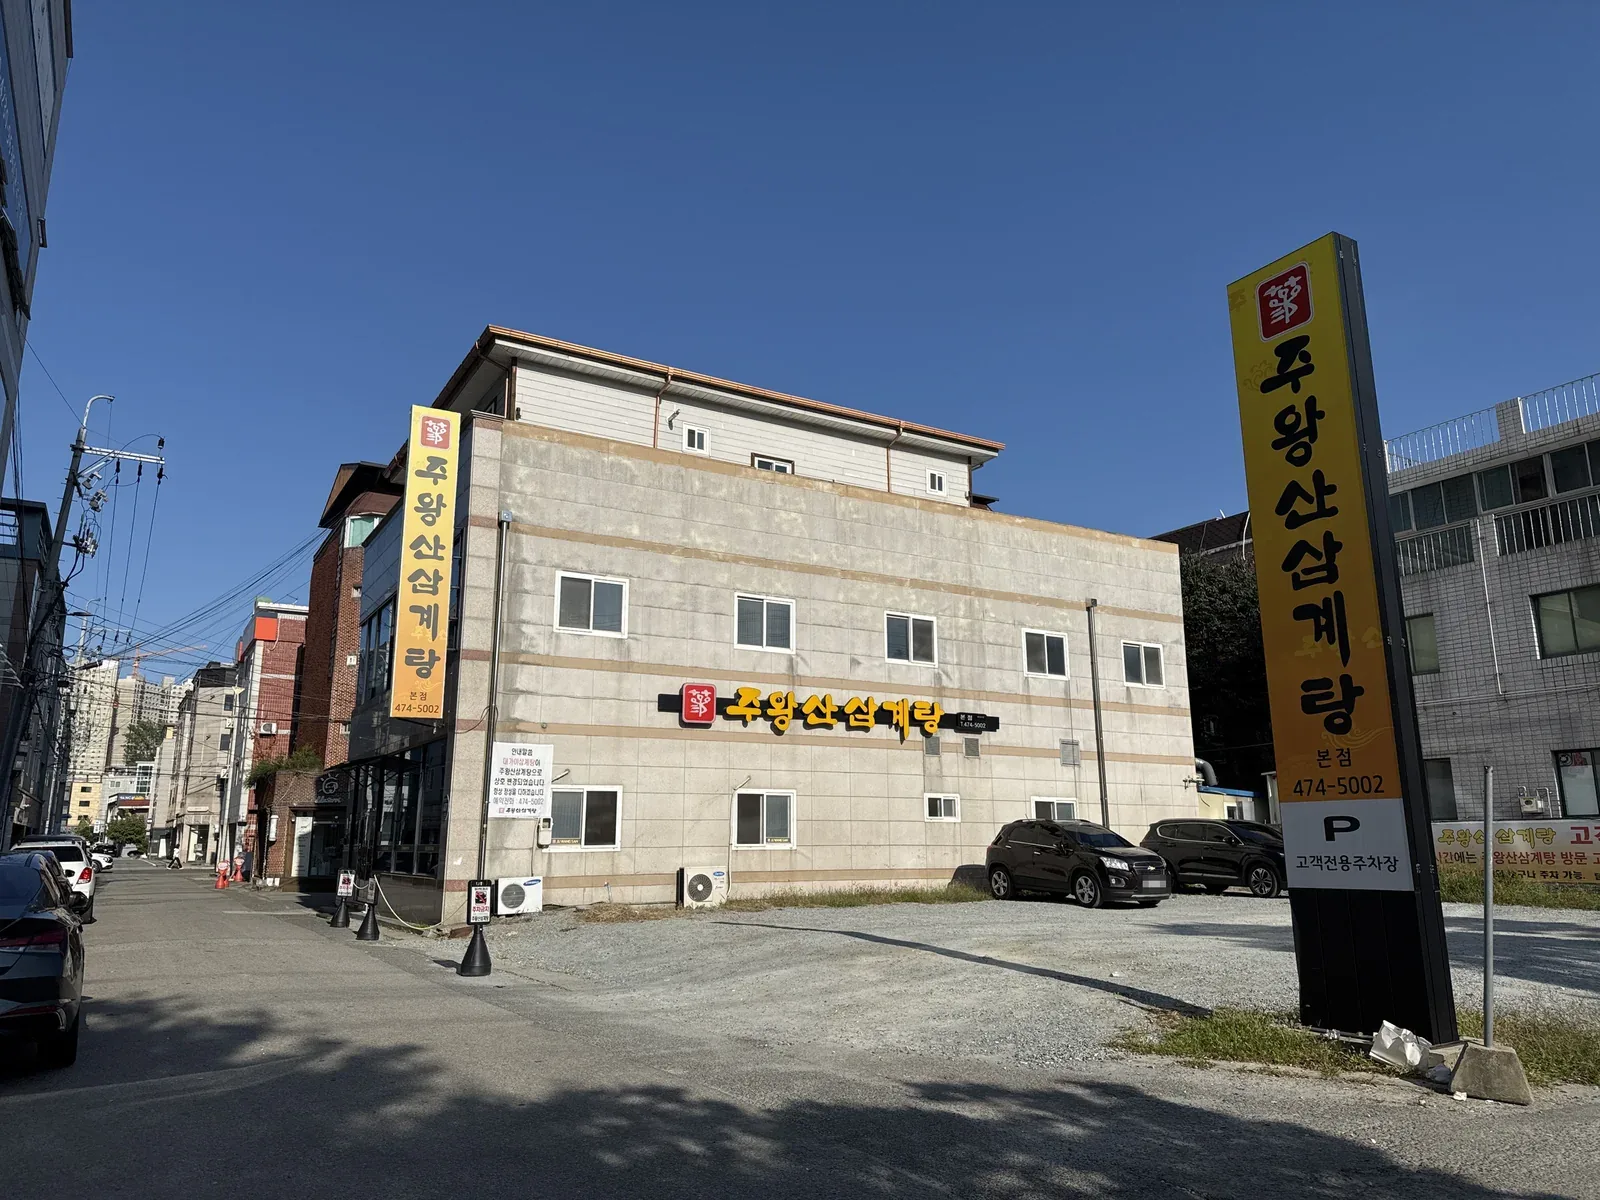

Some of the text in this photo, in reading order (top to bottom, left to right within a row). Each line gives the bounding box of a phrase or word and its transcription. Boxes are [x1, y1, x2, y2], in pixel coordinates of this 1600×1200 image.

[1260, 335, 1365, 735] 주왕산삼계탕
[404, 455, 448, 679] 주왕산삼계탕
[394, 704, 440, 714] 474-5002
[726, 687, 945, 740] 주왕산삼계탕
[1316, 747, 1352, 769] 본점
[1293, 774, 1385, 797] 474-5002
[1323, 815, 1361, 842] P
[1570, 826, 1600, 845] 고
[1295, 855, 1399, 873] 고객전용주차장
[1481, 851, 1556, 865] 왕산삼계탕
[1561, 851, 1588, 865] 방문
